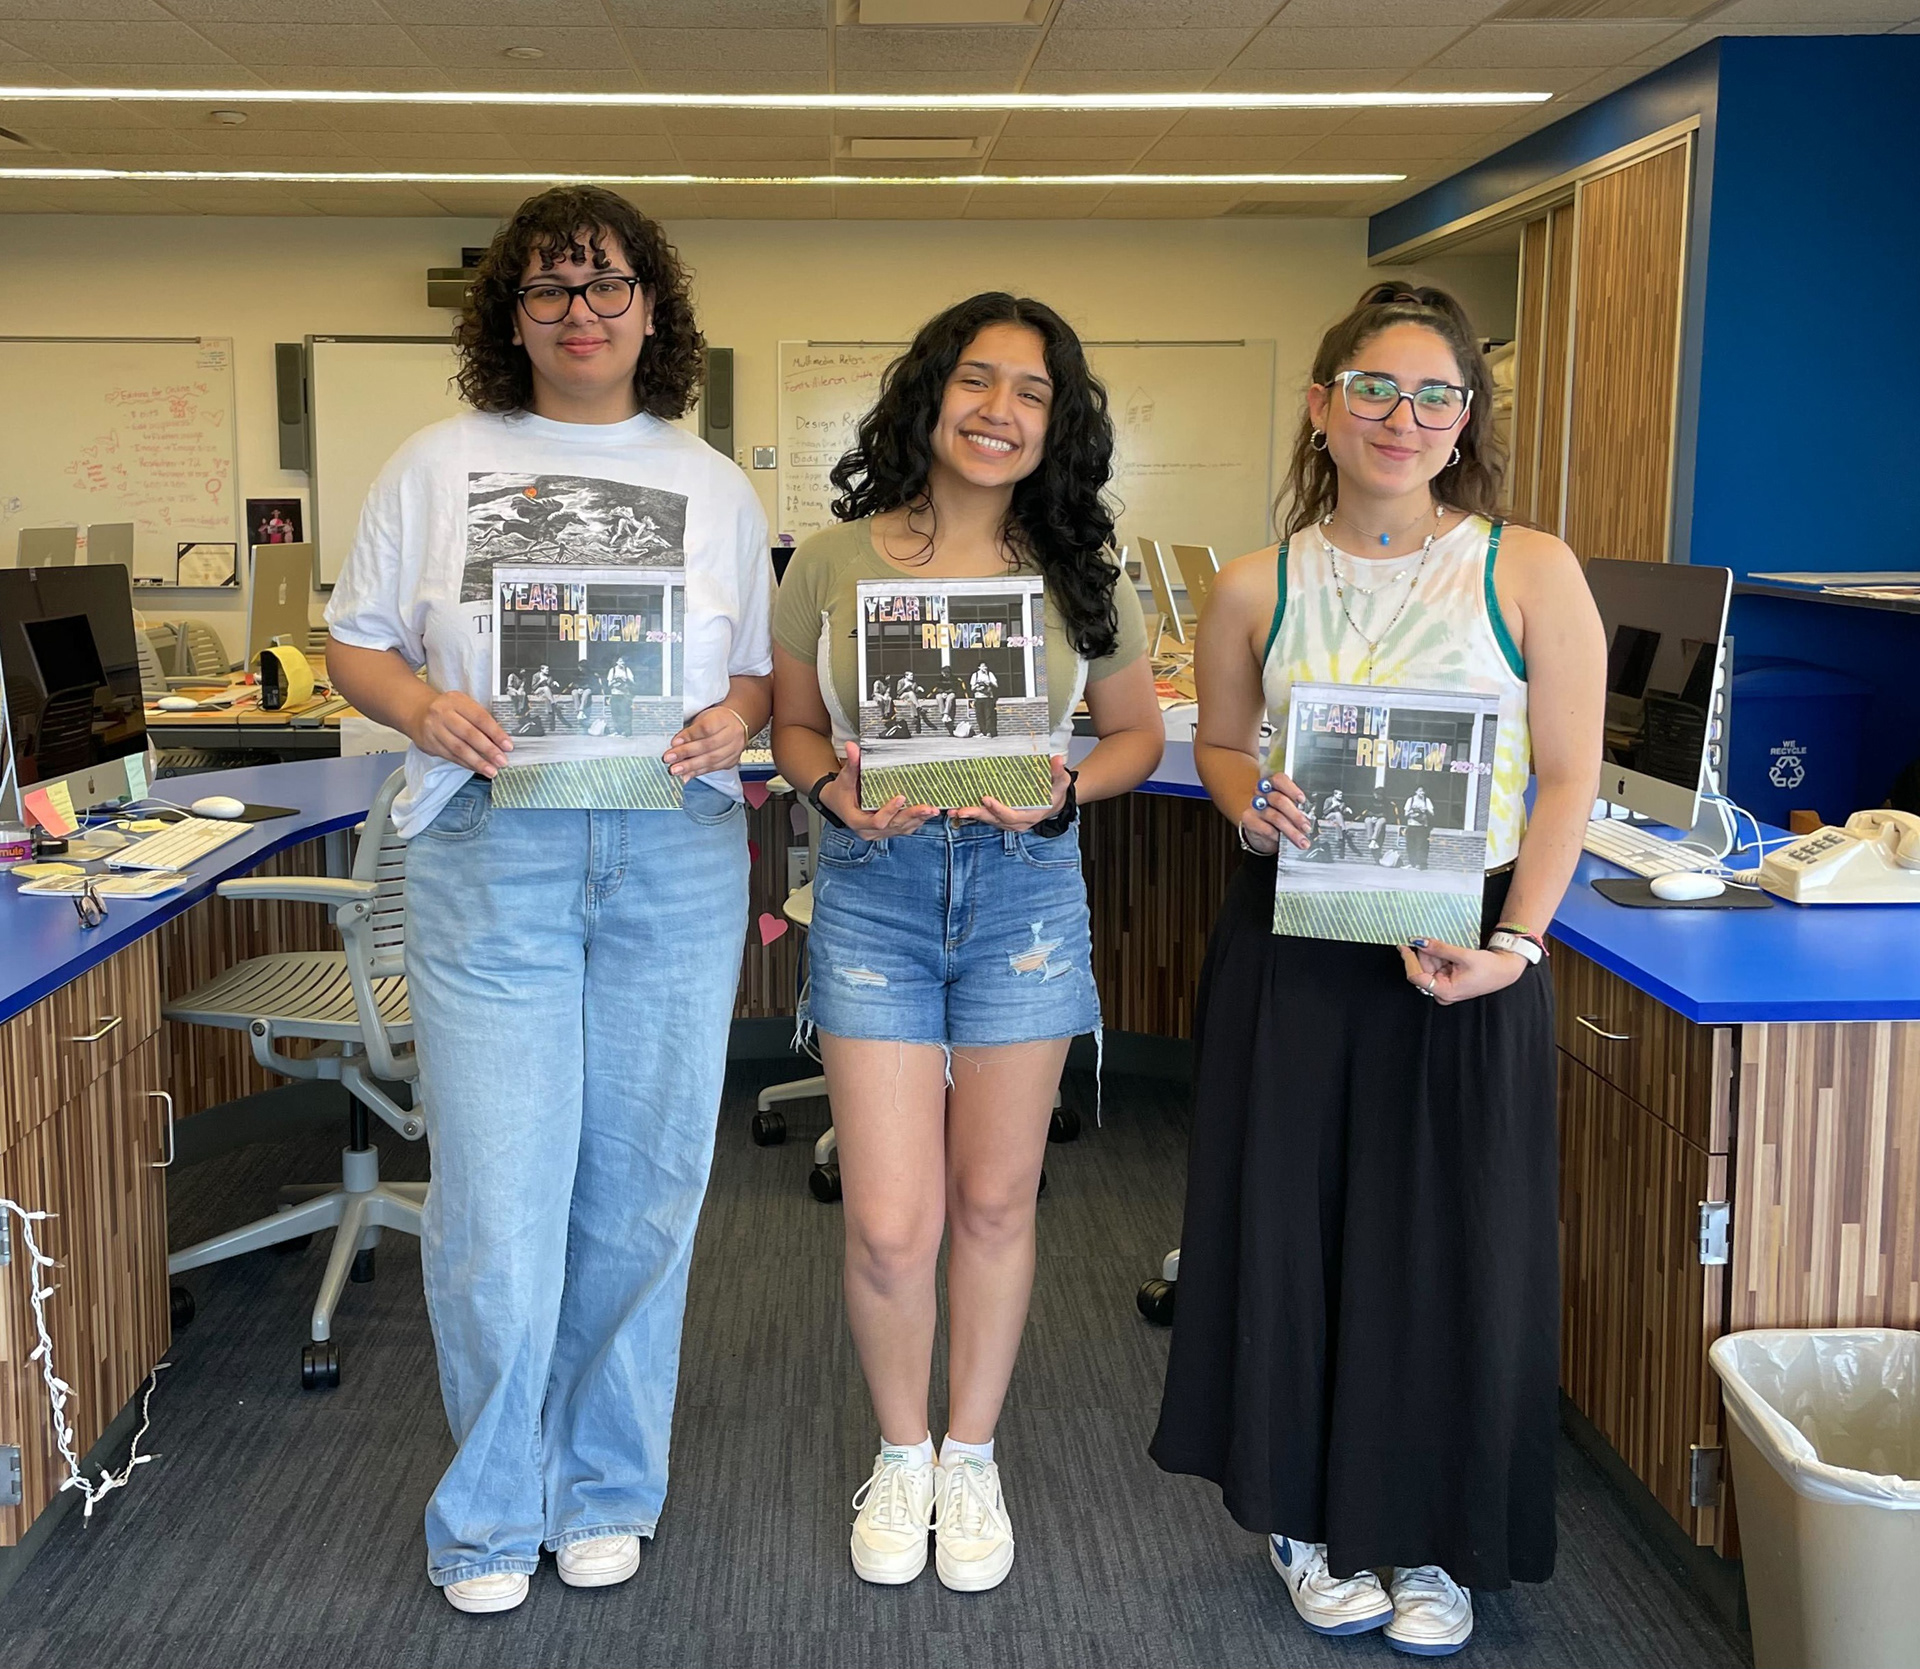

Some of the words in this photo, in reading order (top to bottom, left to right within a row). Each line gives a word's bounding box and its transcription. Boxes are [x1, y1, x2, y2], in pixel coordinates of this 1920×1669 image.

[796, 415, 837, 433] Design
[500, 582, 558, 611] YEAR
[563, 582, 586, 611] IN
[864, 595, 921, 622] YEAR
[926, 594, 947, 621] IN
[559, 613, 642, 642] REVIEW
[645, 630, 683, 643] 2023-24
[921, 622, 1002, 649] REVIEW
[1006, 635, 1044, 648] 2023-24
[1298, 702, 1358, 734] YEAR
[1363, 706, 1388, 736] IN
[1356, 737, 1448, 772] REVIEW
[1450, 760, 1492, 776] 2023-24
[1770, 747, 1807, 756] RECYCLE
[1782, 740, 1796, 748] WE
